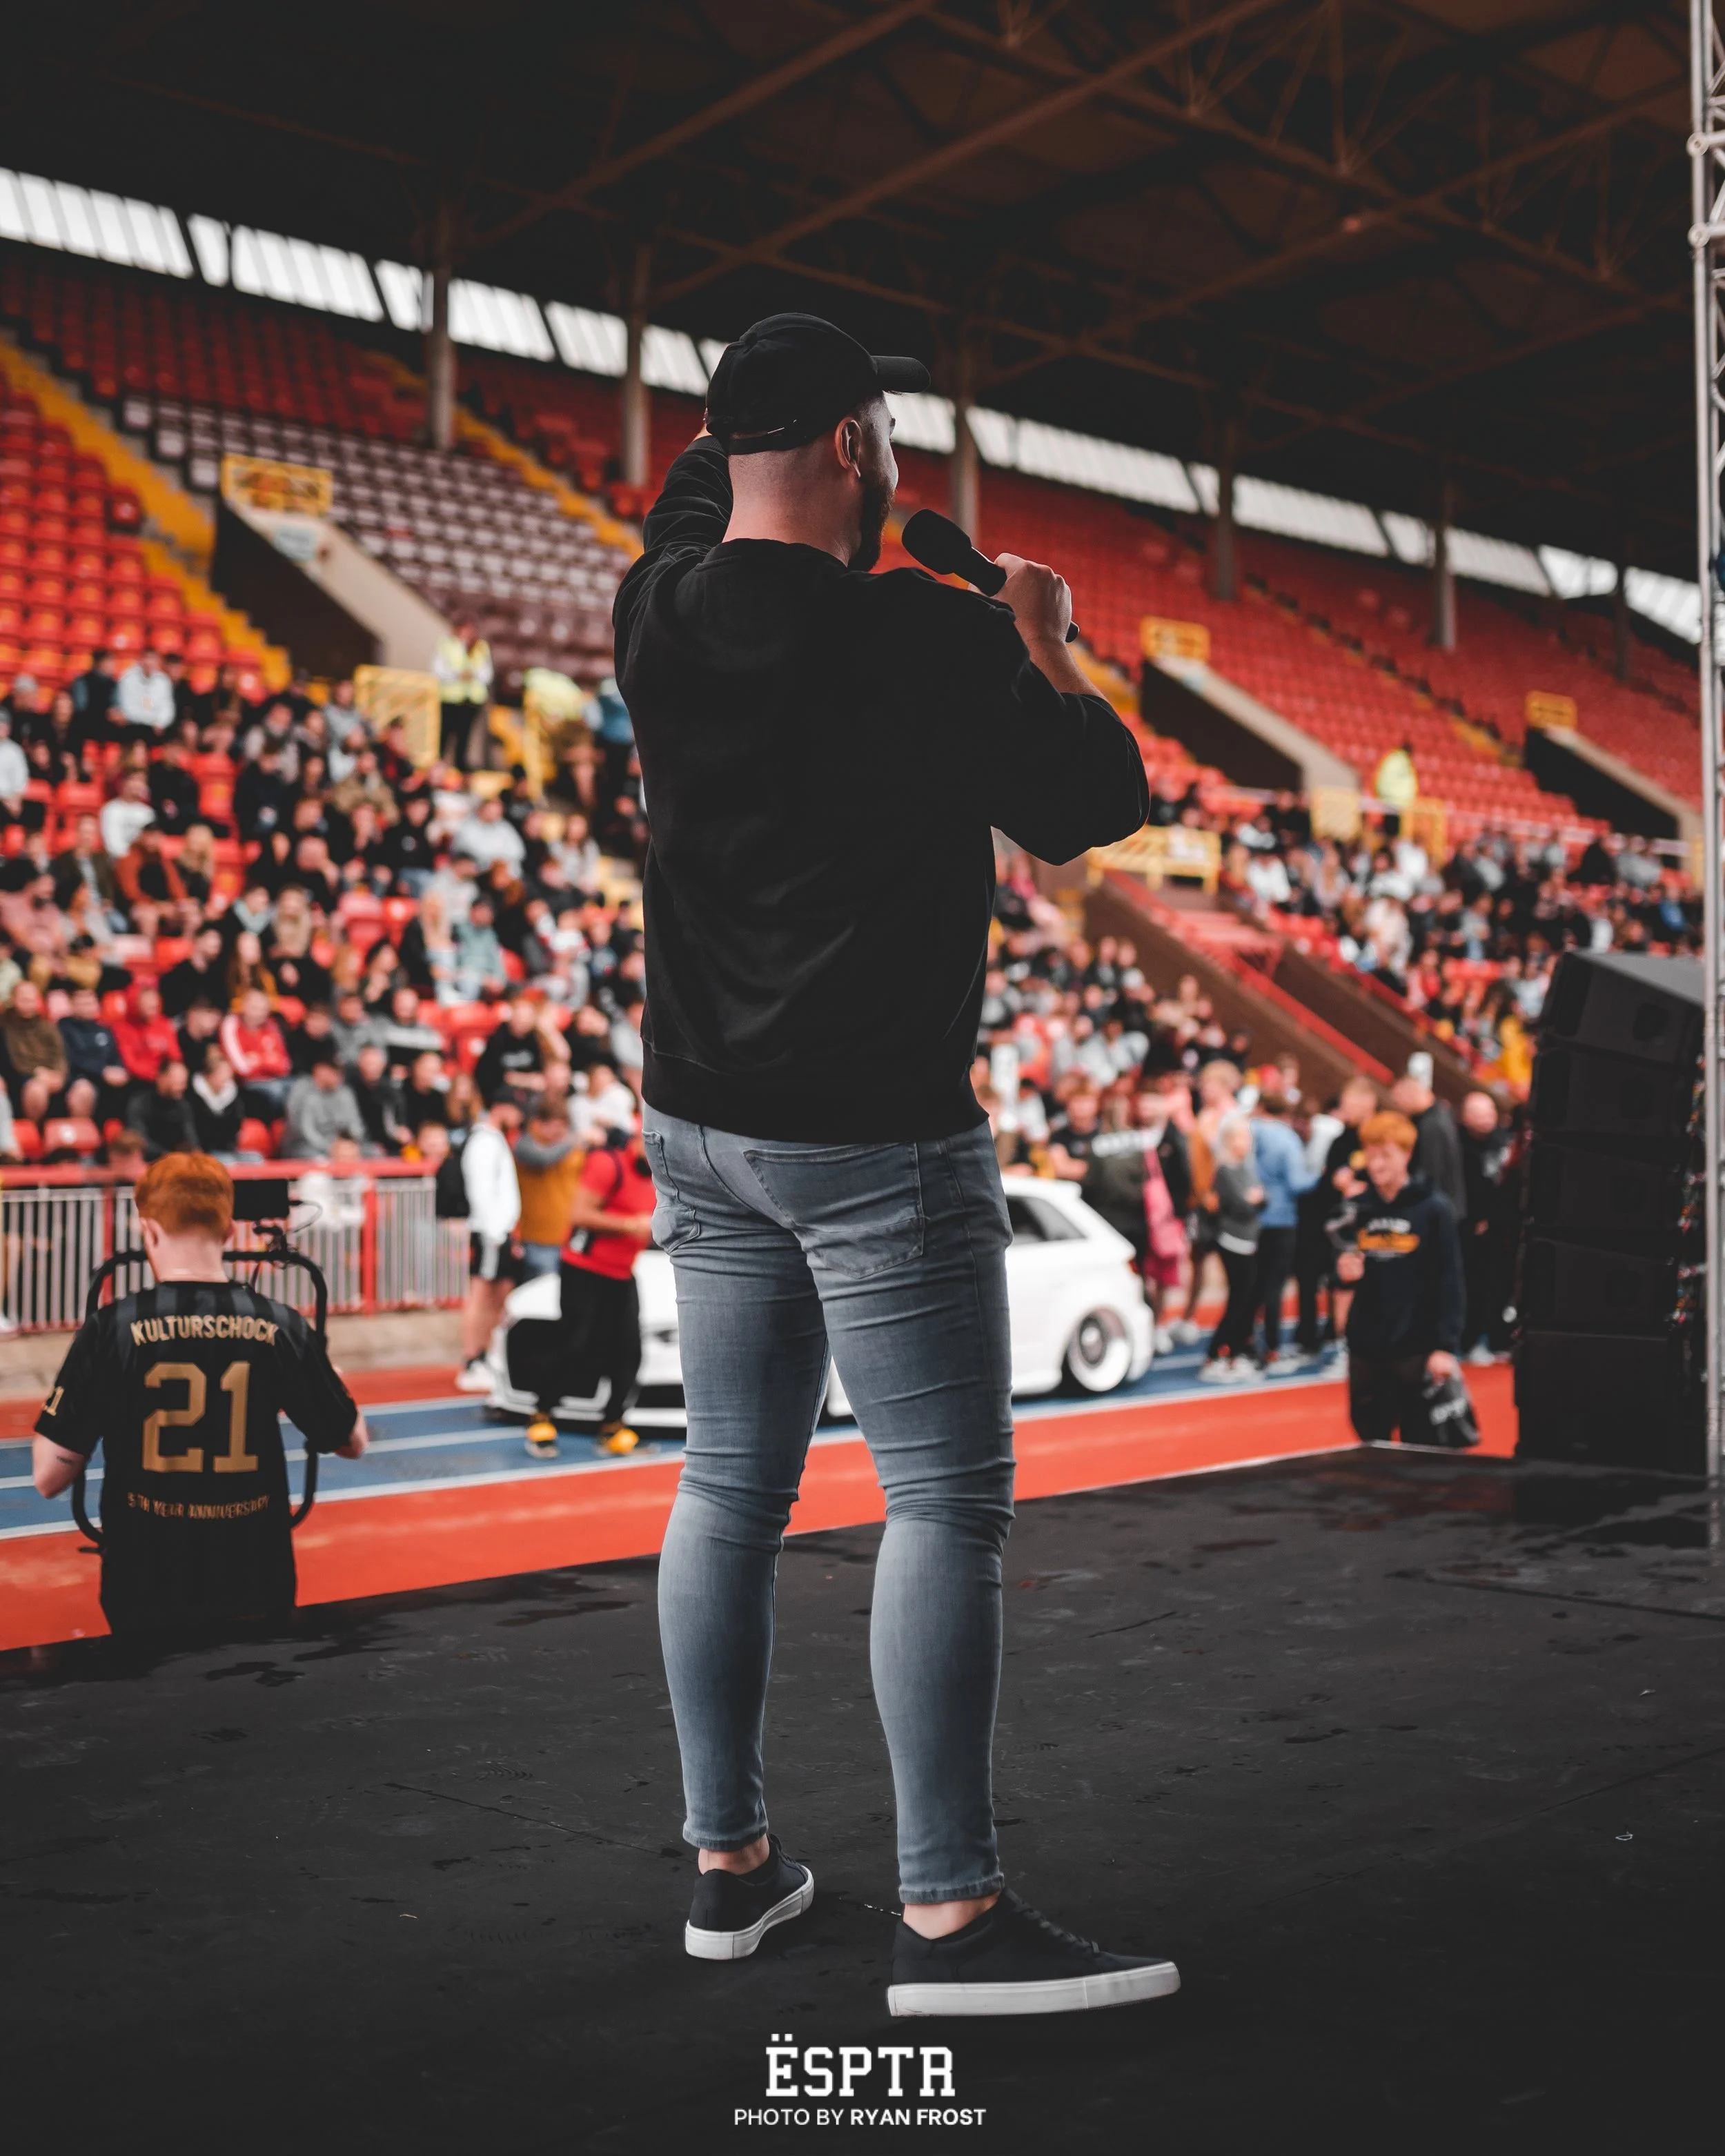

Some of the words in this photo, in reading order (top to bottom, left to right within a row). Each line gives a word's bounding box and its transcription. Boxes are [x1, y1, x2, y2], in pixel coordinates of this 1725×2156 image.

[130, 1315, 279, 1346] KULTURSCHOCK
[44, 1385, 64, 1416] 1
[143, 1361, 259, 1473] 21
[152, 1499, 184, 1517] YEAR
